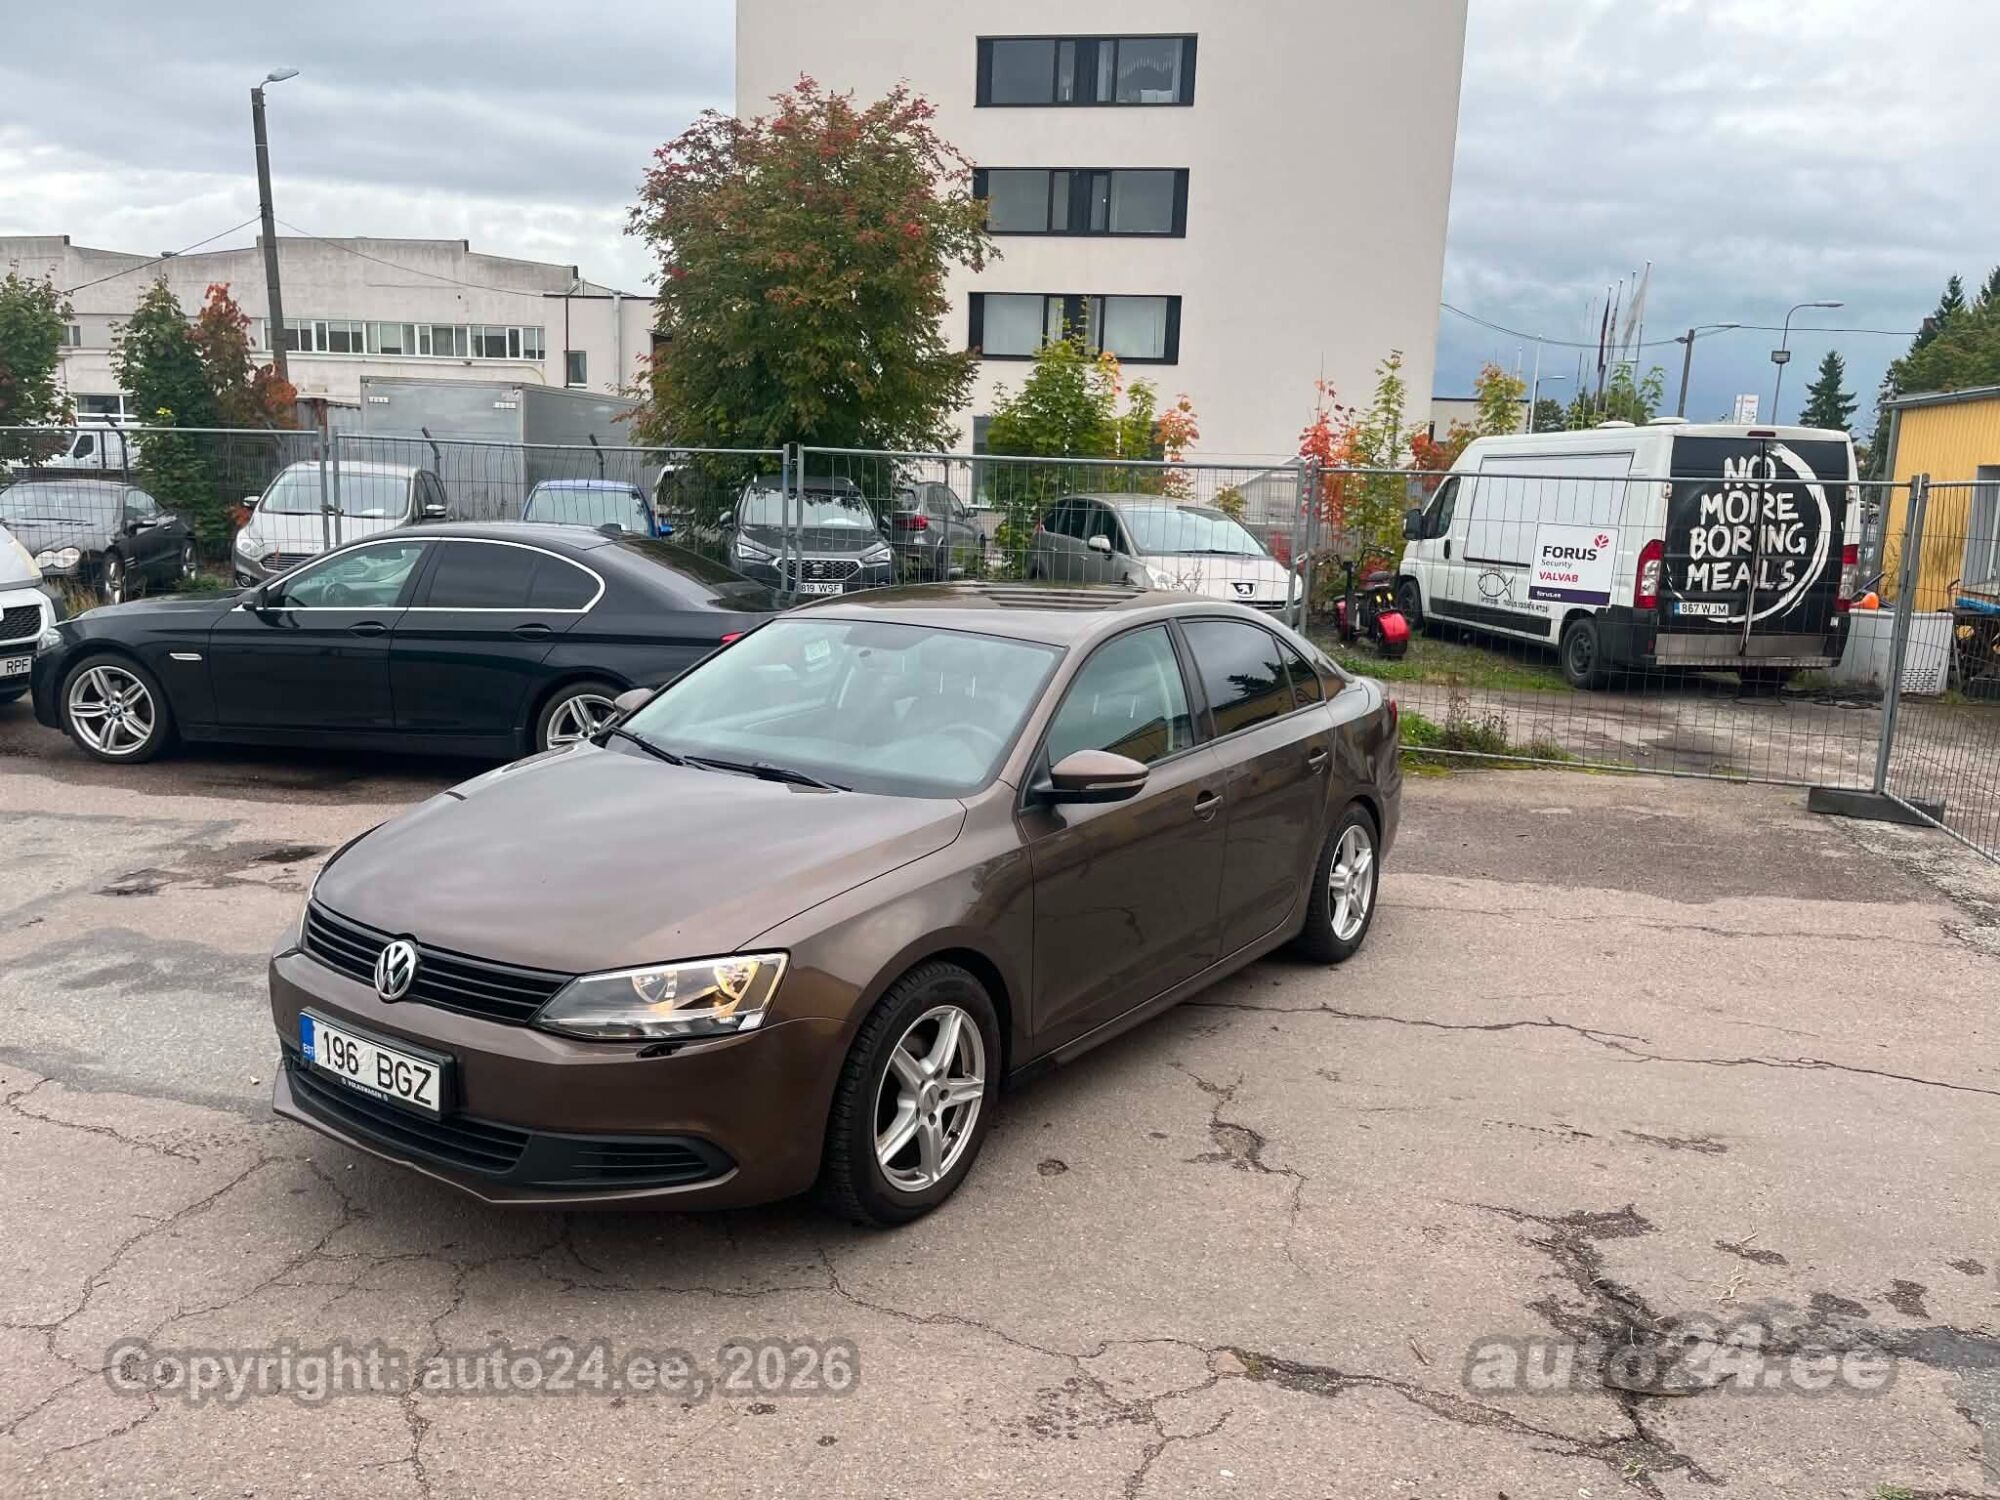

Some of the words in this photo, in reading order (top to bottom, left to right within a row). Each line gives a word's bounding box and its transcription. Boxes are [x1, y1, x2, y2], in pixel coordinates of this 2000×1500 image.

[1724, 455, 1776, 490] NO
[1700, 490, 1799, 525] MORE
[1689, 522, 1807, 561] BORING
[1542, 545, 1598, 561] FORUS
[1541, 558, 1573, 570] Security
[1539, 570, 1579, 583] VALVAB
[1685, 559, 1796, 593] MEALS
[802, 584, 815, 593] 819
[819, 584, 840, 593] WSF
[1681, 603, 1700, 613] 867
[6, 658, 30, 673] RPF
[323, 1030, 359, 1076] 196
[376, 1051, 432, 1106] BGZ
